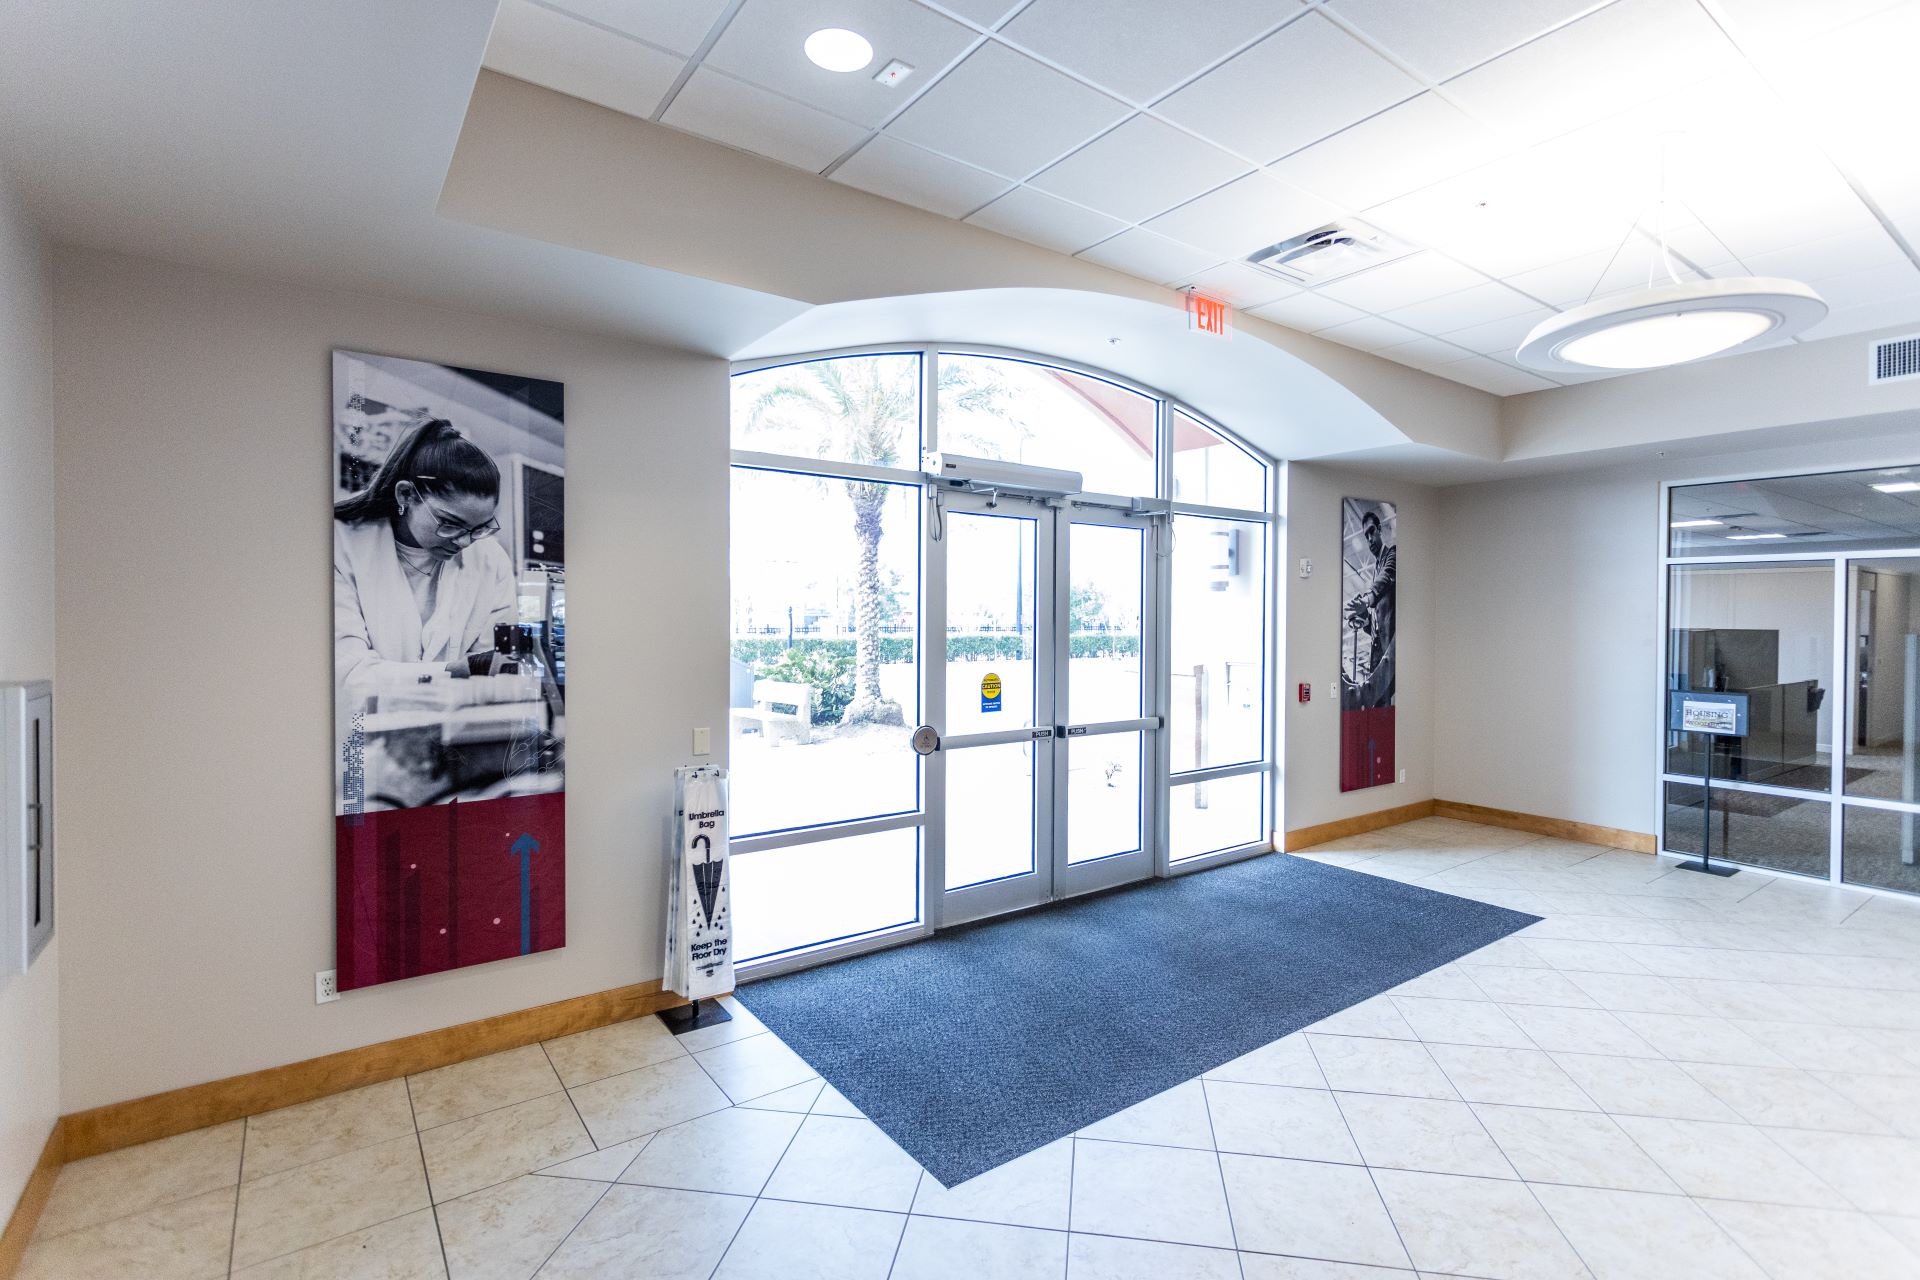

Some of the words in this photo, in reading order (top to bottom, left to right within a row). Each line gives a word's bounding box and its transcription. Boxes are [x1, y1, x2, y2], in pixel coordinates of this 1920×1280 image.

[1197, 296, 1224, 335] EXIT
[1685, 709, 1729, 719] HOUSING
[689, 810, 725, 821] Umbrella
[699, 821, 715, 829] Bag
[691, 942, 712, 951] Keep
[714, 938, 727, 946] the
[692, 951, 711, 961] Floor
[713, 948, 727, 956] Dry
